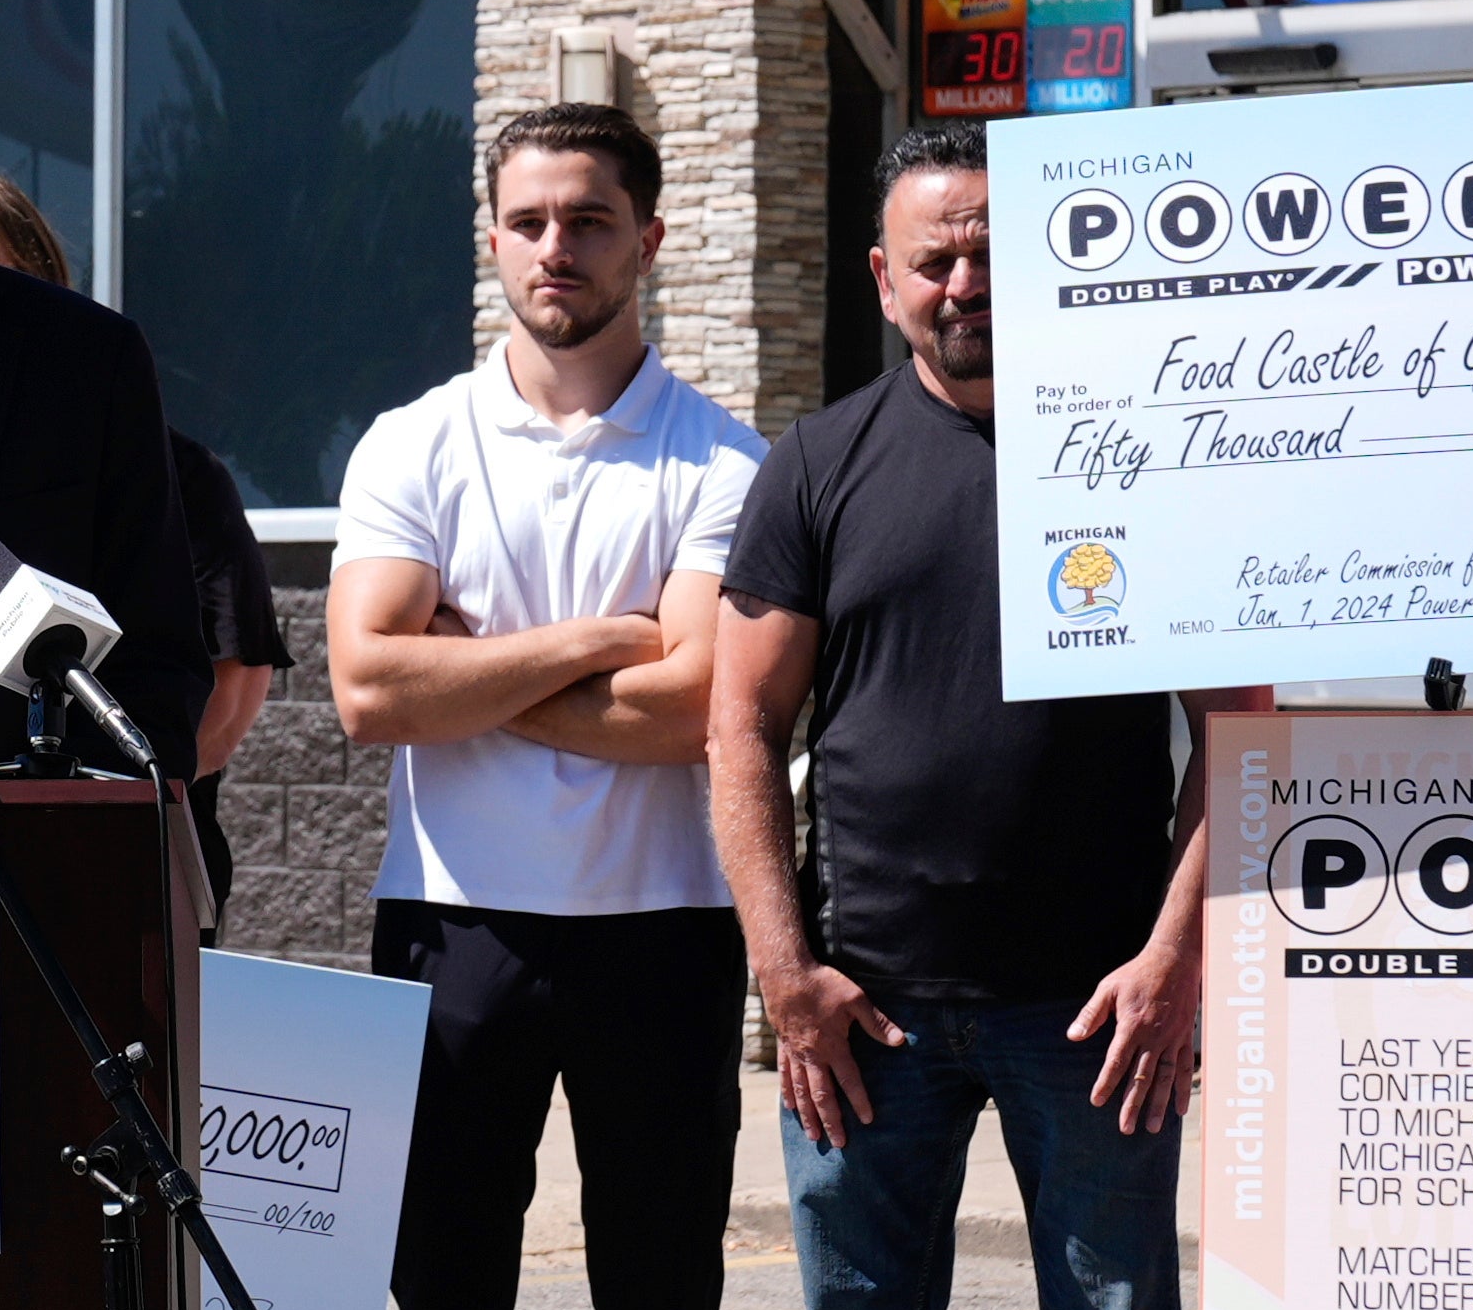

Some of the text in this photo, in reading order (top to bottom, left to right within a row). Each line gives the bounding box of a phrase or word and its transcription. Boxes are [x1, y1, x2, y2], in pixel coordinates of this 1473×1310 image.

[963, 25, 1126, 82] 30 20
[935, 82, 1118, 109] MILLION MILLION
[1043, 151, 1193, 182] MICHIGAN
[1153, 335, 1247, 395] Food
[1257, 324, 1384, 390] Castle
[1401, 320, 1447, 398] of
[1050, 419, 1155, 491] Fifty
[1180, 405, 1354, 463] Thousand
[1045, 526, 1126, 546] MICHIGAN
[1236, 552, 1330, 589] Retailer
[1340, 549, 1455, 584] Commission
[1169, 619, 1215, 635] MEMO
[1237, 593, 1284, 632] Jan.
[1300, 598, 1321, 631] 1,
[1330, 593, 1394, 622] 2024
[1271, 778, 1473, 805] MICHIGAN
[264, 1201, 335, 1234] 00/100
